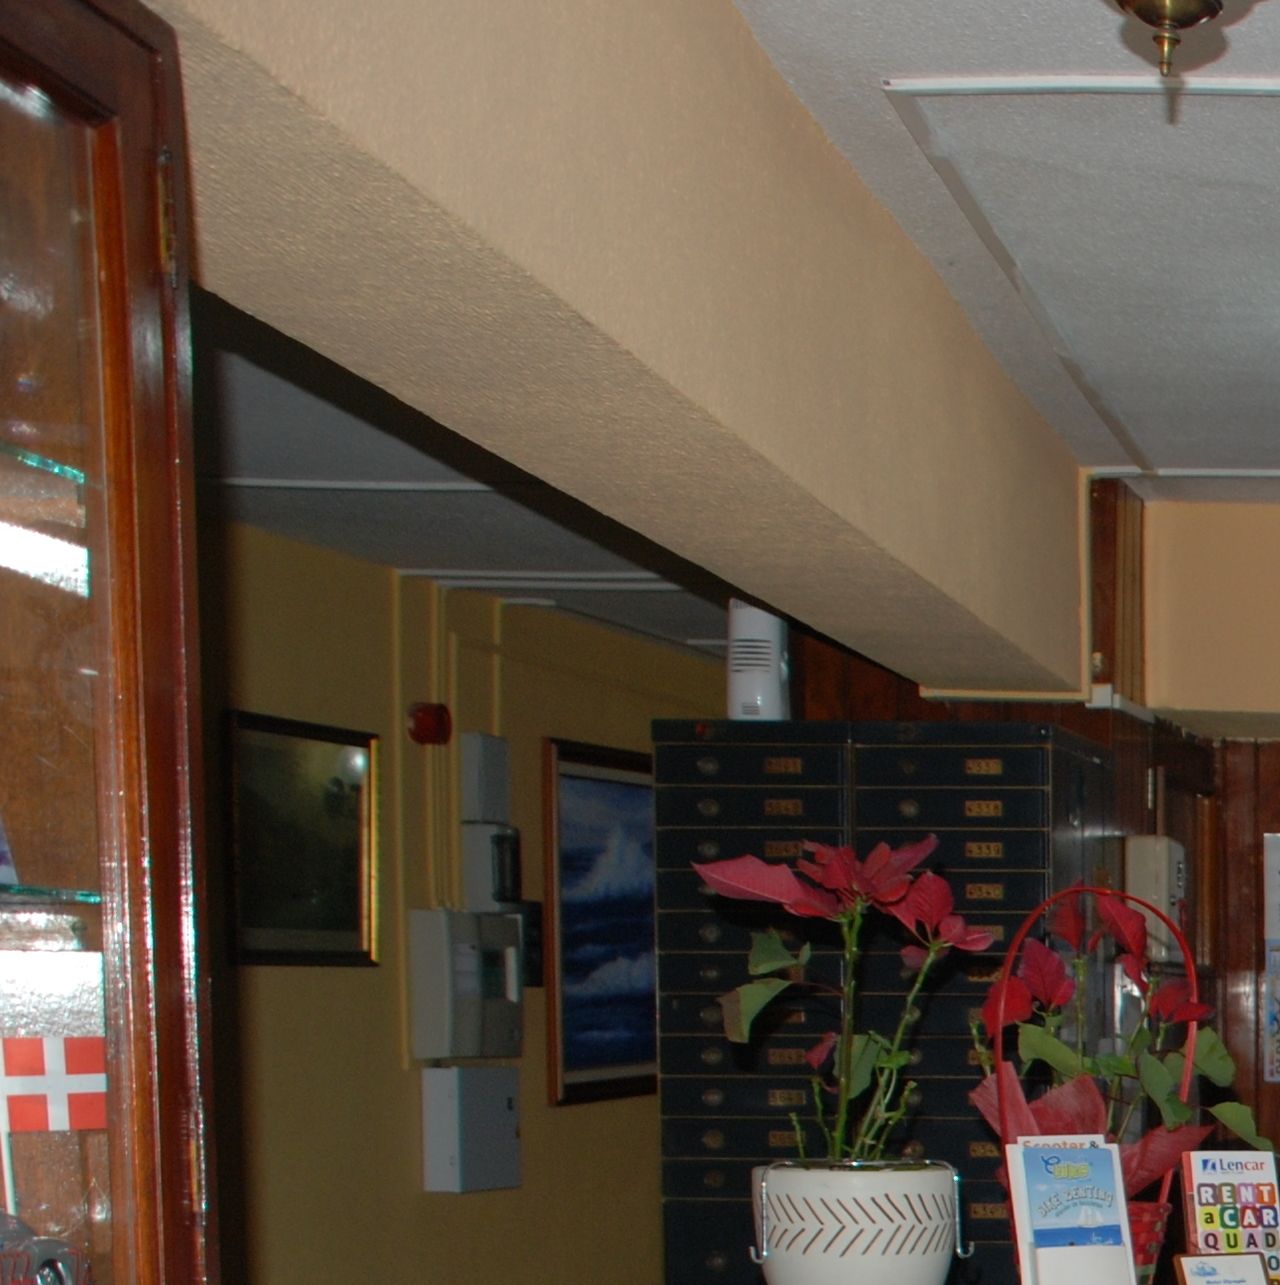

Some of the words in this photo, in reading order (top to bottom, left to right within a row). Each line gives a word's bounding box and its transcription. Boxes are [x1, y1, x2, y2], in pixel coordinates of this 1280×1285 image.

[1219, 1158, 1265, 1171] Lencar
[1200, 1185, 1272, 1204] RENT
[1204, 1211, 1215, 1224] a
[1223, 1208, 1275, 1227] CAR
[1203, 1232, 1277, 1251] QUAD
